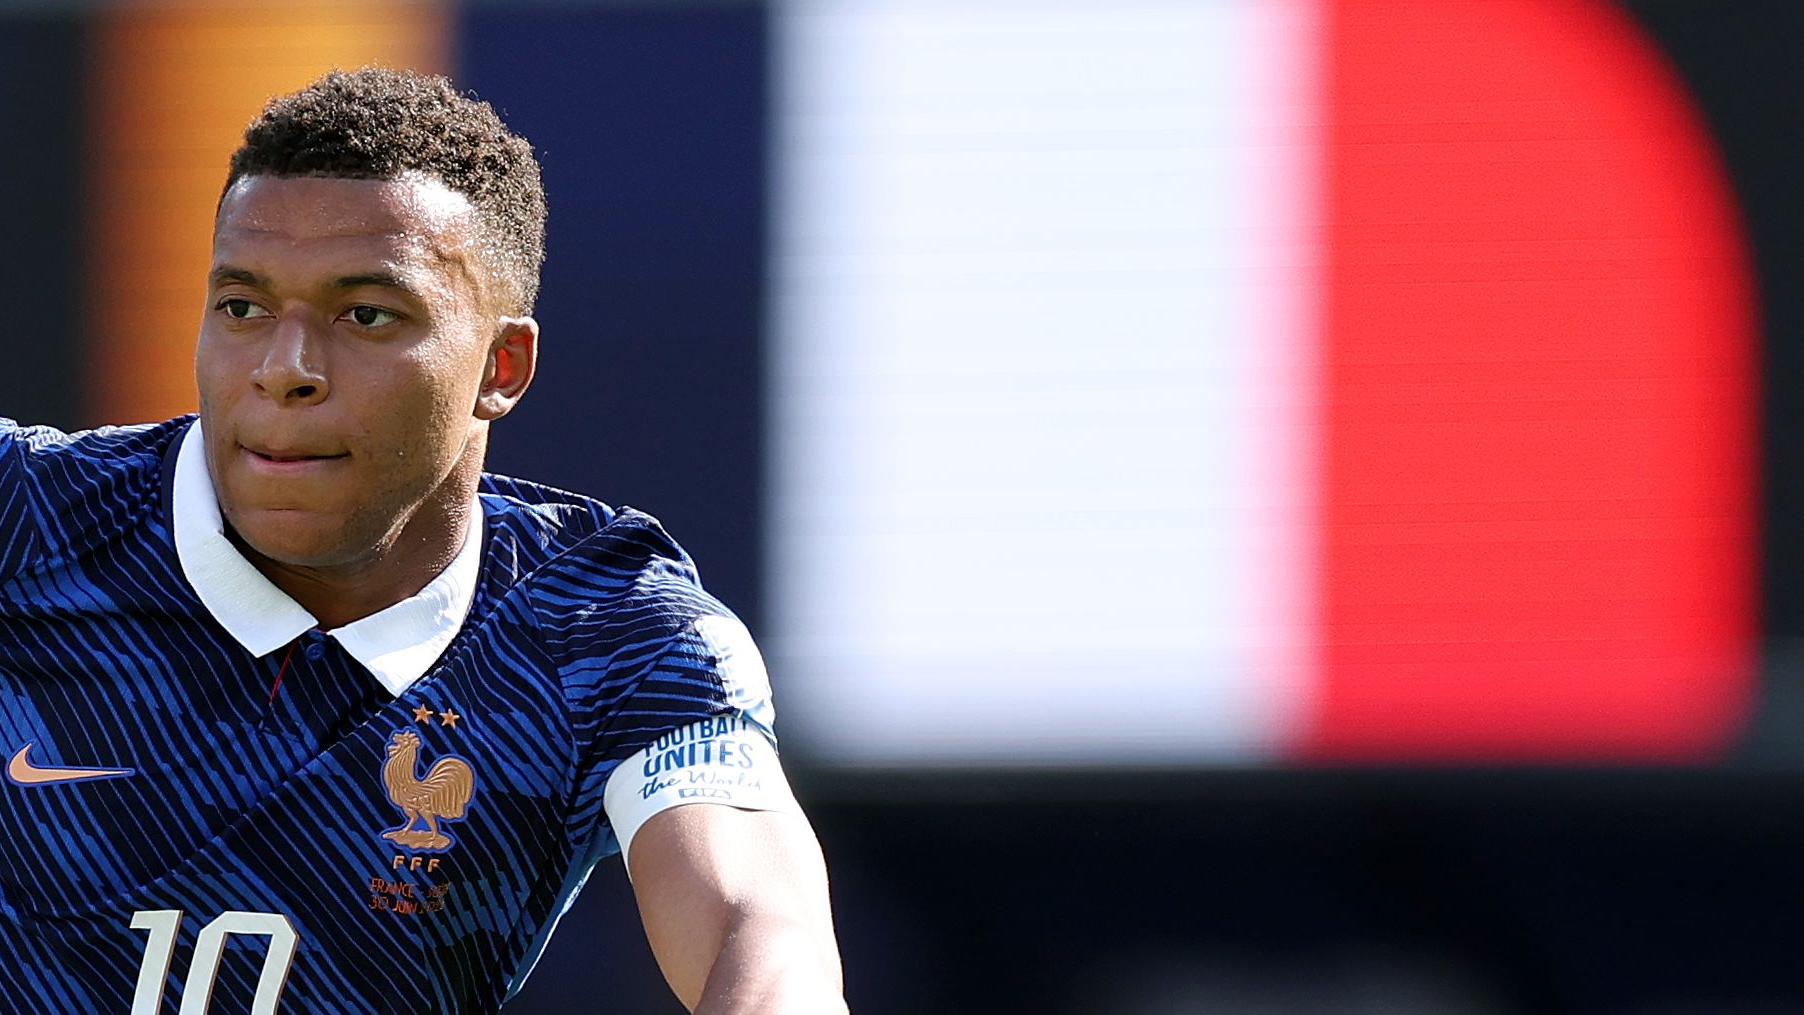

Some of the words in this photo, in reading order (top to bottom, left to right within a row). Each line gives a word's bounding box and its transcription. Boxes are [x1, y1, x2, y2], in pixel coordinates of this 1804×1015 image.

[643, 740, 753, 777] UNITES
[638, 777, 682, 799] the
[393, 855, 440, 873] FFF
